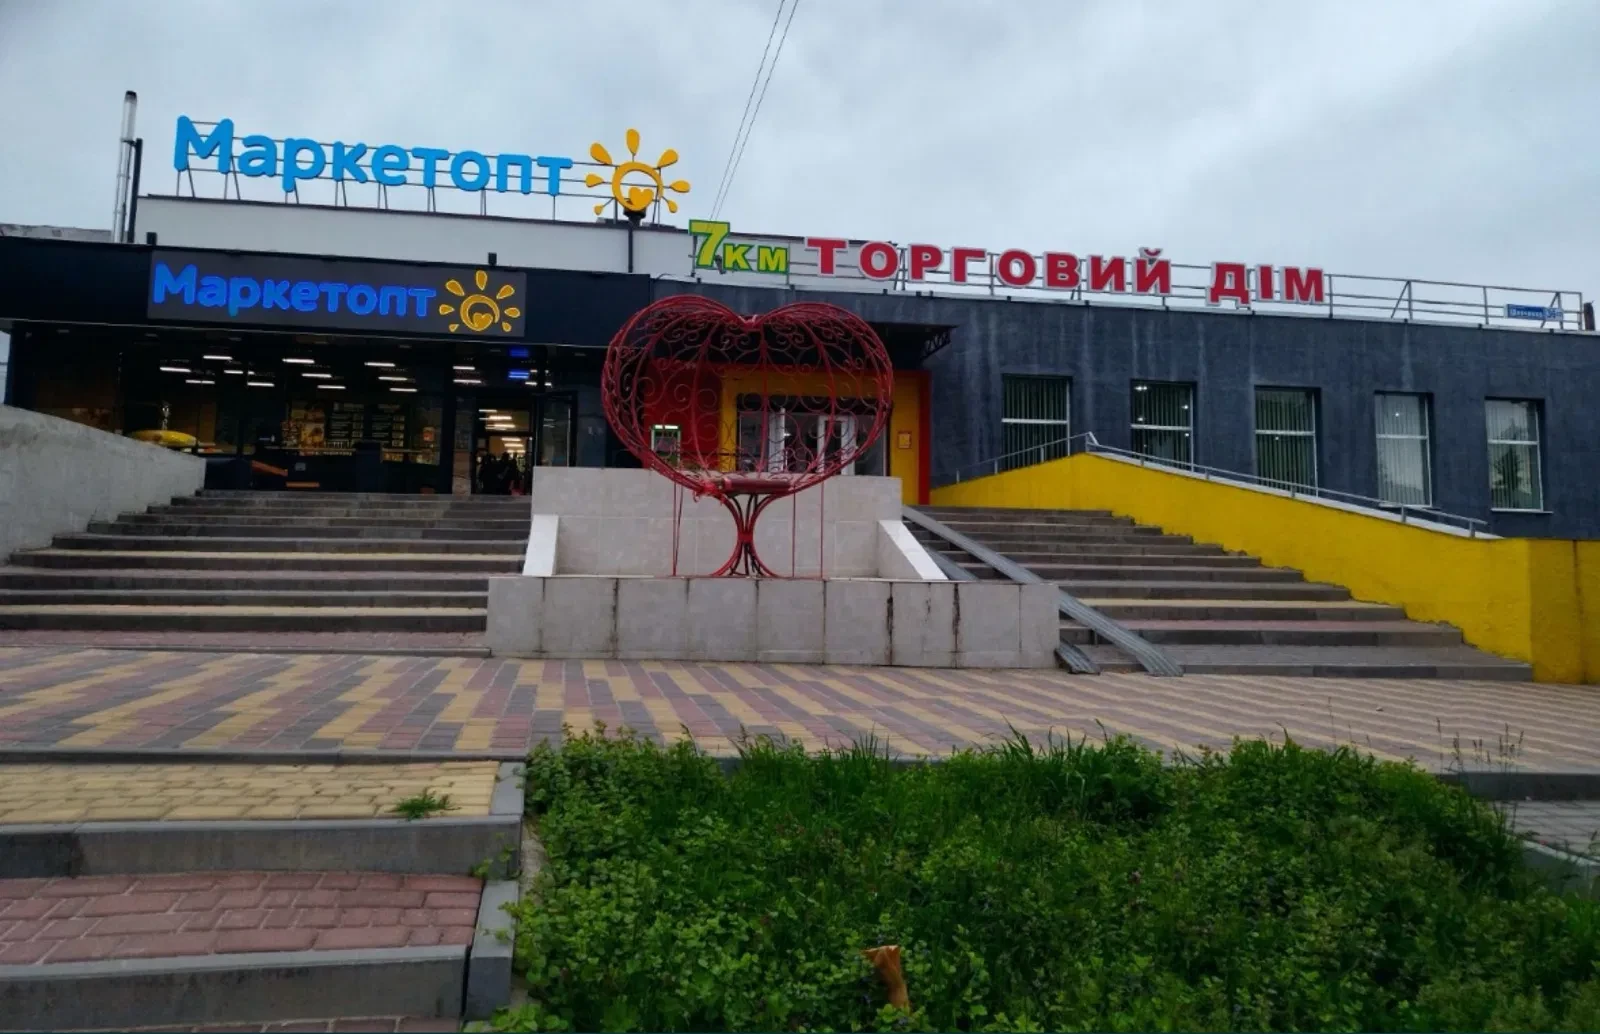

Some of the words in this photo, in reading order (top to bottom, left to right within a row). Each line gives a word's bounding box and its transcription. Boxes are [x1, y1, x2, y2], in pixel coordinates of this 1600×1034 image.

[174, 115, 573, 197] Маркетопт
[153, 262, 437, 318] Маркетопт
[804, 235, 1172, 296] ТОРГОВИЙ
[1209, 261, 1326, 307] ДІМ
